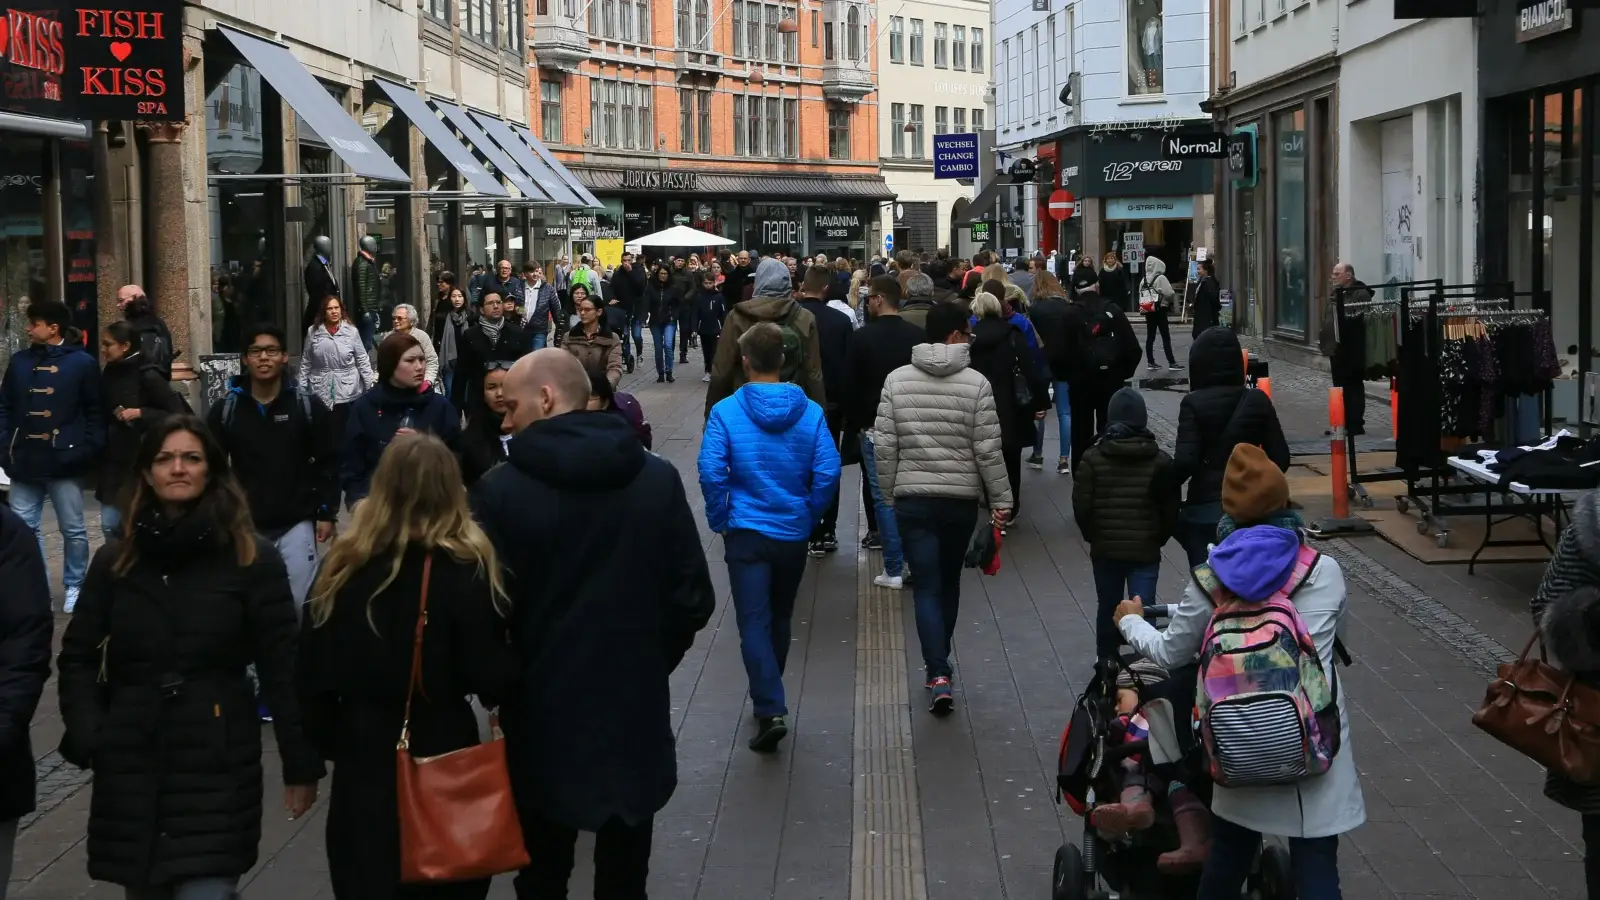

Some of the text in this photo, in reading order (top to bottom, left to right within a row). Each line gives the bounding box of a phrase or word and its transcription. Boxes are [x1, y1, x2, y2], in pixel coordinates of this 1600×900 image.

[75, 8, 165, 39] FISH
[7, 8, 64, 75] KISS
[80, 66, 166, 97] KISS
[137, 101, 168, 114] SPA
[937, 140, 975, 149] WECHSEL
[1169, 137, 1221, 155] Normal
[938, 152, 974, 160] CHANGE
[940, 164, 973, 172] CAMBIO
[1103, 159, 1183, 182] 12'eren
[624, 169, 700, 189] JORCKS PASSAGE
[573, 216, 598, 226] STORY
[814, 216, 859, 227] HAVANNA
[547, 227, 566, 236] SKAGEN
[827, 229, 848, 237] SHOES
